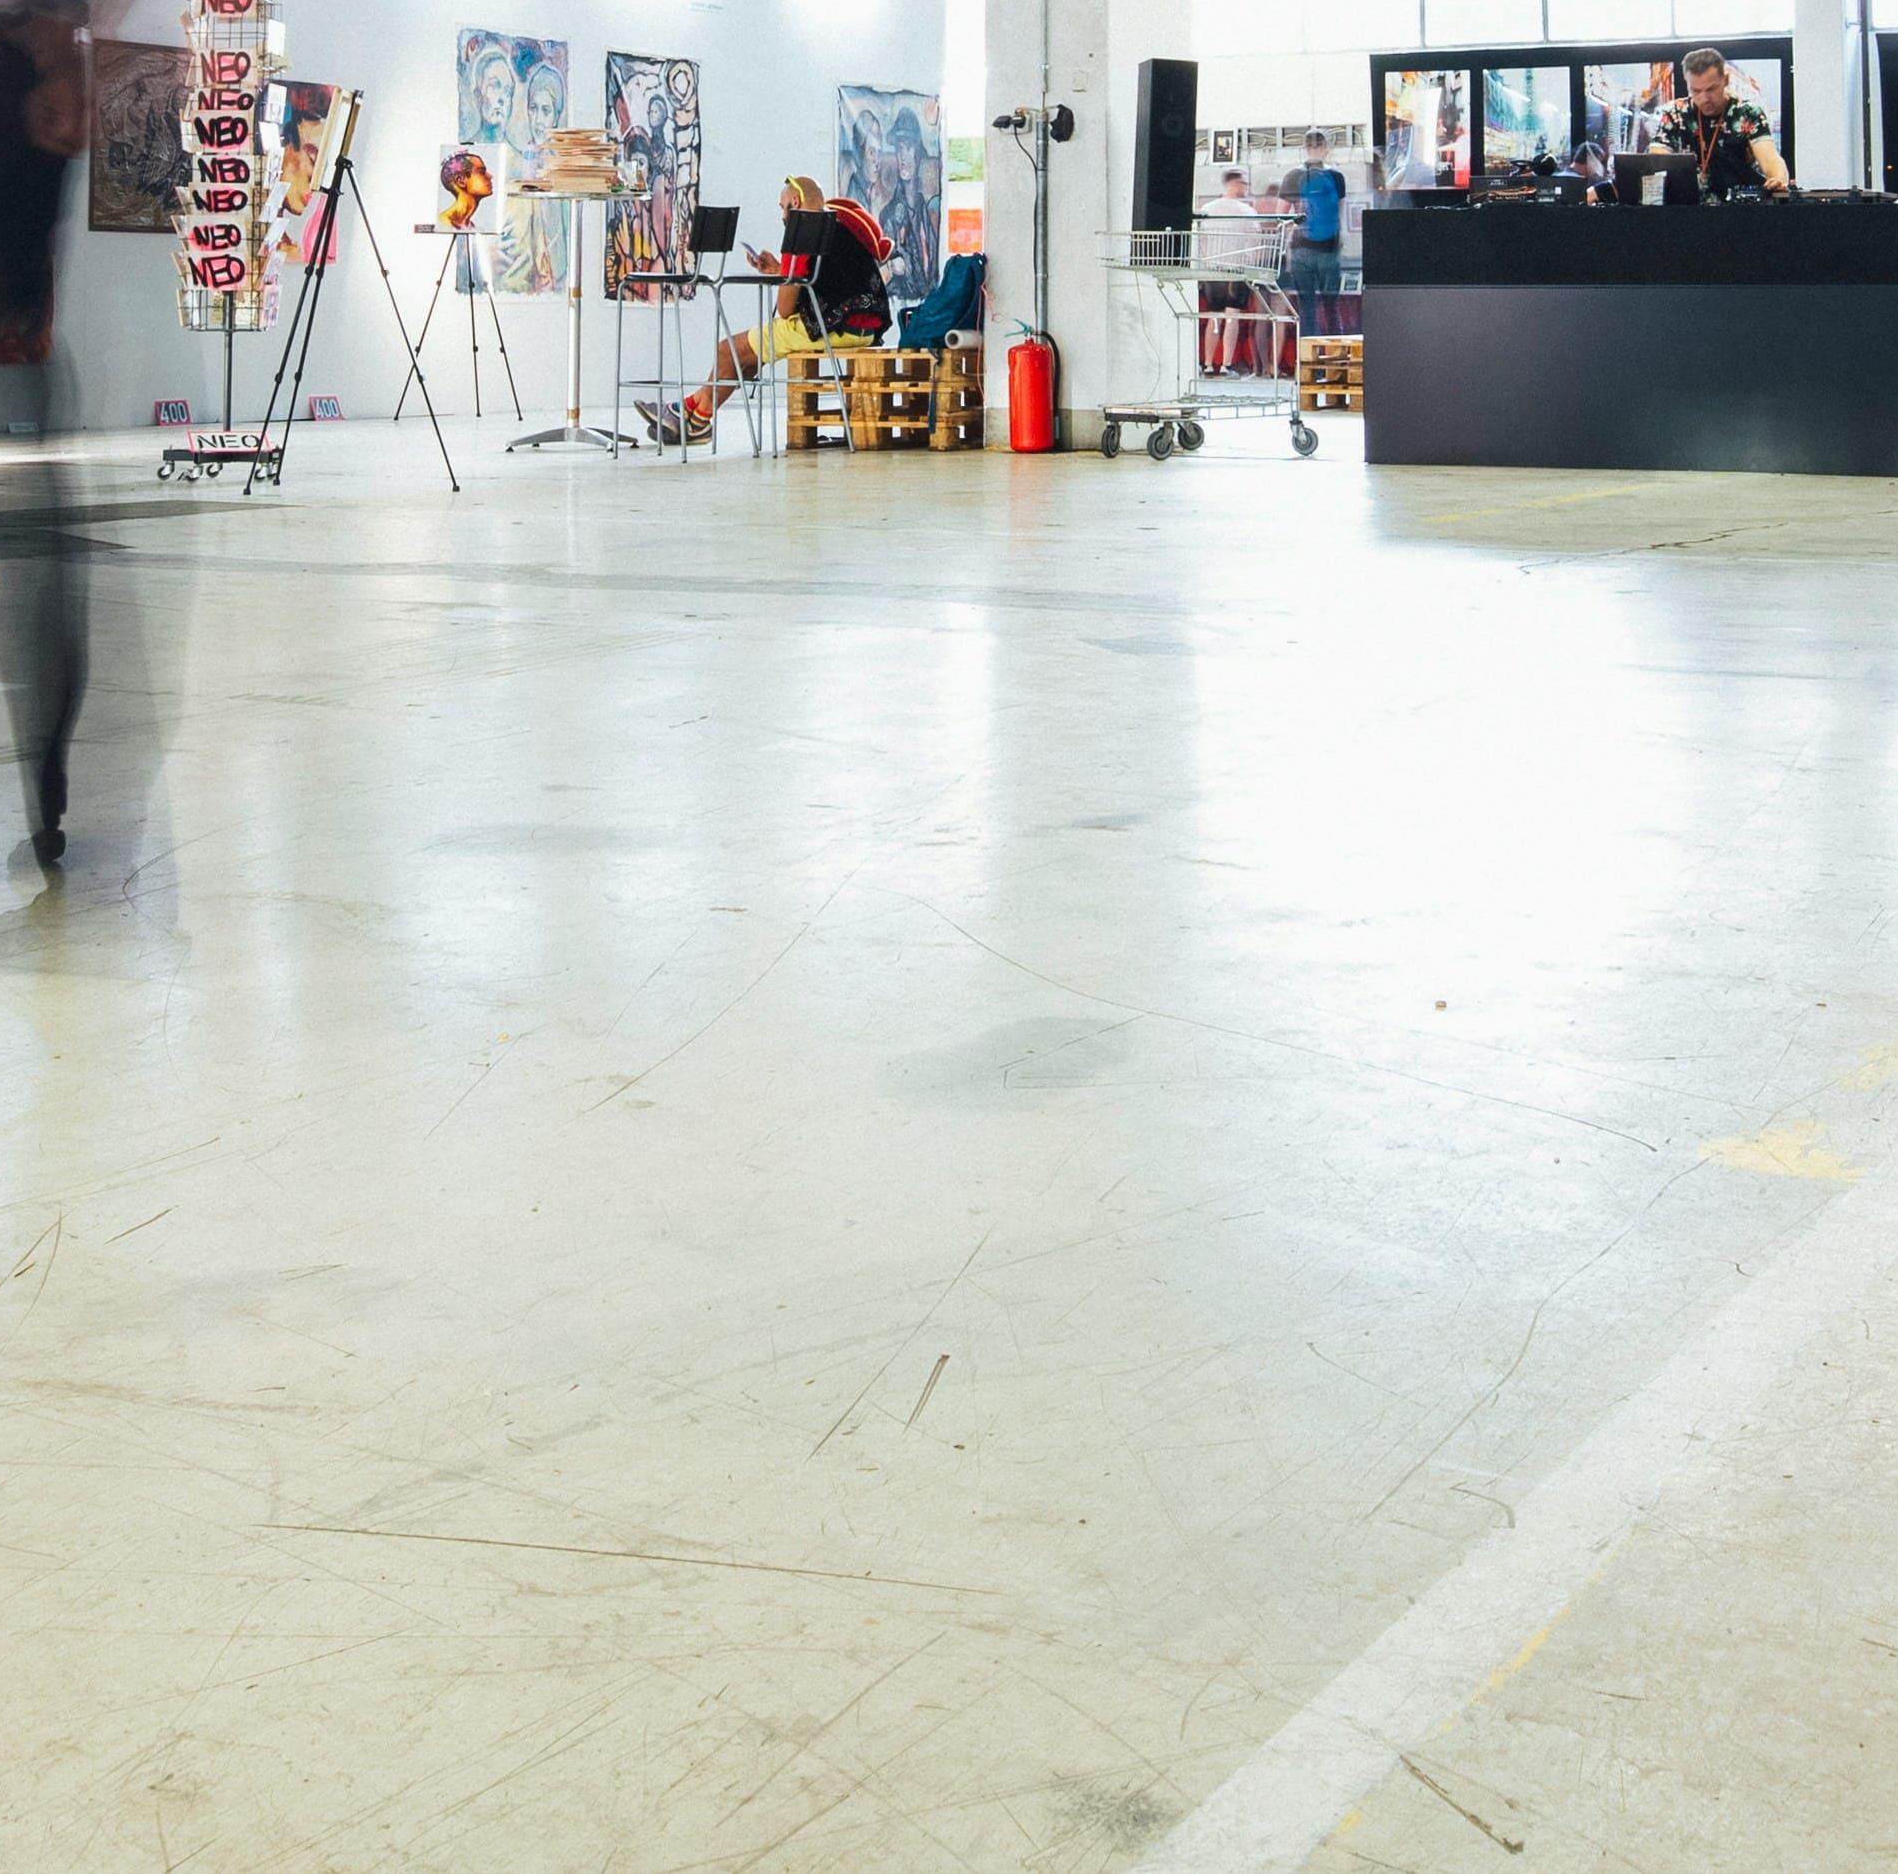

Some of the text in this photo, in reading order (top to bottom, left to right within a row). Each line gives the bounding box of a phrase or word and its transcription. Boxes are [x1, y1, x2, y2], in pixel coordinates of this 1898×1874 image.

[201, 49, 251, 84] NEO
[198, 88, 254, 111] NEO
[194, 116, 248, 148] NEO
[198, 158, 250, 183] NEO
[192, 189, 248, 212] NEO
[193, 224, 241, 250] NEO
[188, 254, 245, 288] NEO
[160, 402, 187, 423] 400
[315, 398, 340, 419] 400
[197, 434, 261, 448] NEO
